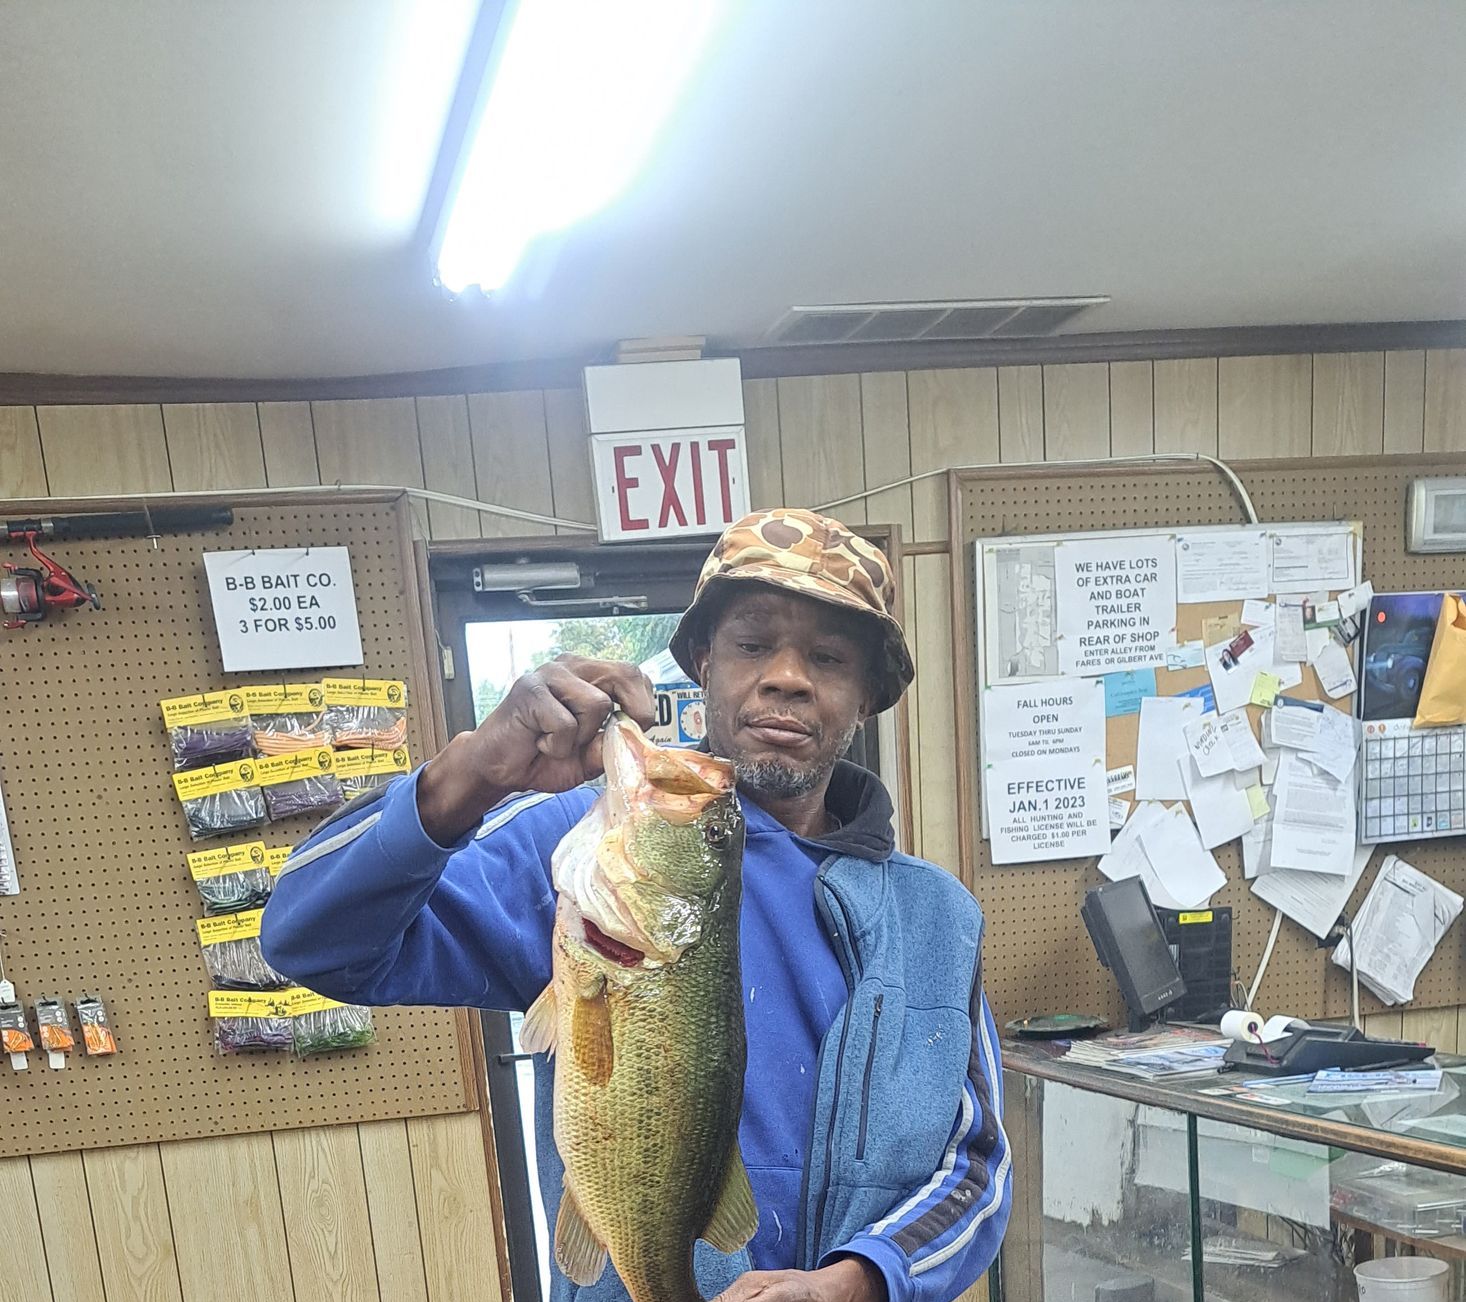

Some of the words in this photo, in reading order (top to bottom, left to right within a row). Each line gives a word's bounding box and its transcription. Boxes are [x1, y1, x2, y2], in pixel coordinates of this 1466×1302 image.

[613, 438, 736, 531] EXIT
[1075, 562, 1093, 573] WE
[1096, 560, 1126, 572] HAVE
[1129, 558, 1158, 569] LOTS
[225, 576, 256, 591] B-B
[261, 574, 300, 590] BAIT
[306, 572, 337, 588] CO.
[1076, 577, 1091, 588] OF
[1094, 574, 1132, 586] EXTRA
[1134, 572, 1158, 584] CAR
[1089, 590, 1112, 601] AND
[1115, 587, 1146, 599] BOAT
[249, 596, 292, 613] $2.00
[297, 595, 320, 610] EA
[1095, 602, 1142, 615] TRAILER
[239, 619, 249, 634] 3
[254, 618, 290, 633] FOR
[294, 615, 337, 632] $5.00
[1087, 617, 1136, 630] PARKING
[1139, 616, 1150, 626] IN
[1079, 634, 1110, 647] REAR
[1113, 633, 1128, 645] OF
[1130, 631, 1160, 643] SHOP
[1084, 647, 1109, 657] ENTER
[1110, 646, 1133, 655] ALLEY
[1134, 644, 1156, 653] FROM
[1075, 658, 1101, 668] FARES
[1105, 657, 1115, 665] OR
[1116, 654, 1147, 664] GILBERT
[1149, 653, 1164, 661] AVE
[1017, 699, 1039, 709] FALL
[1041, 696, 1073, 708] HOURS
[1032, 713, 1059, 724] OPEN
[1008, 729, 1037, 738] TUESDAY
[1038, 728, 1056, 736] THRU
[1057, 727, 1083, 735] SUNDAY
[1011, 750, 1035, 758] CLOSED
[1048, 746, 1080, 755] MONDAYS
[189, 775, 203, 783] Bait
[1007, 777, 1086, 795] EFFECTIVE
[1008, 799, 1049, 814] JAN.1
[1054, 795, 1086, 810] 2023
[1030, 813, 1064, 823] HUNTING
[1067, 811, 1084, 819] AND
[1000, 825, 1029, 834] FISHING
[1033, 822, 1065, 832] LICENSE
[1066, 820, 1085, 829] WILL
[1086, 819, 1097, 827] BE
[1011, 833, 1048, 843] CHARGED
[1051, 830, 1070, 839] $1.00
[1071, 829, 1087, 837] PER
[1033, 841, 1065, 850] LICENSE
